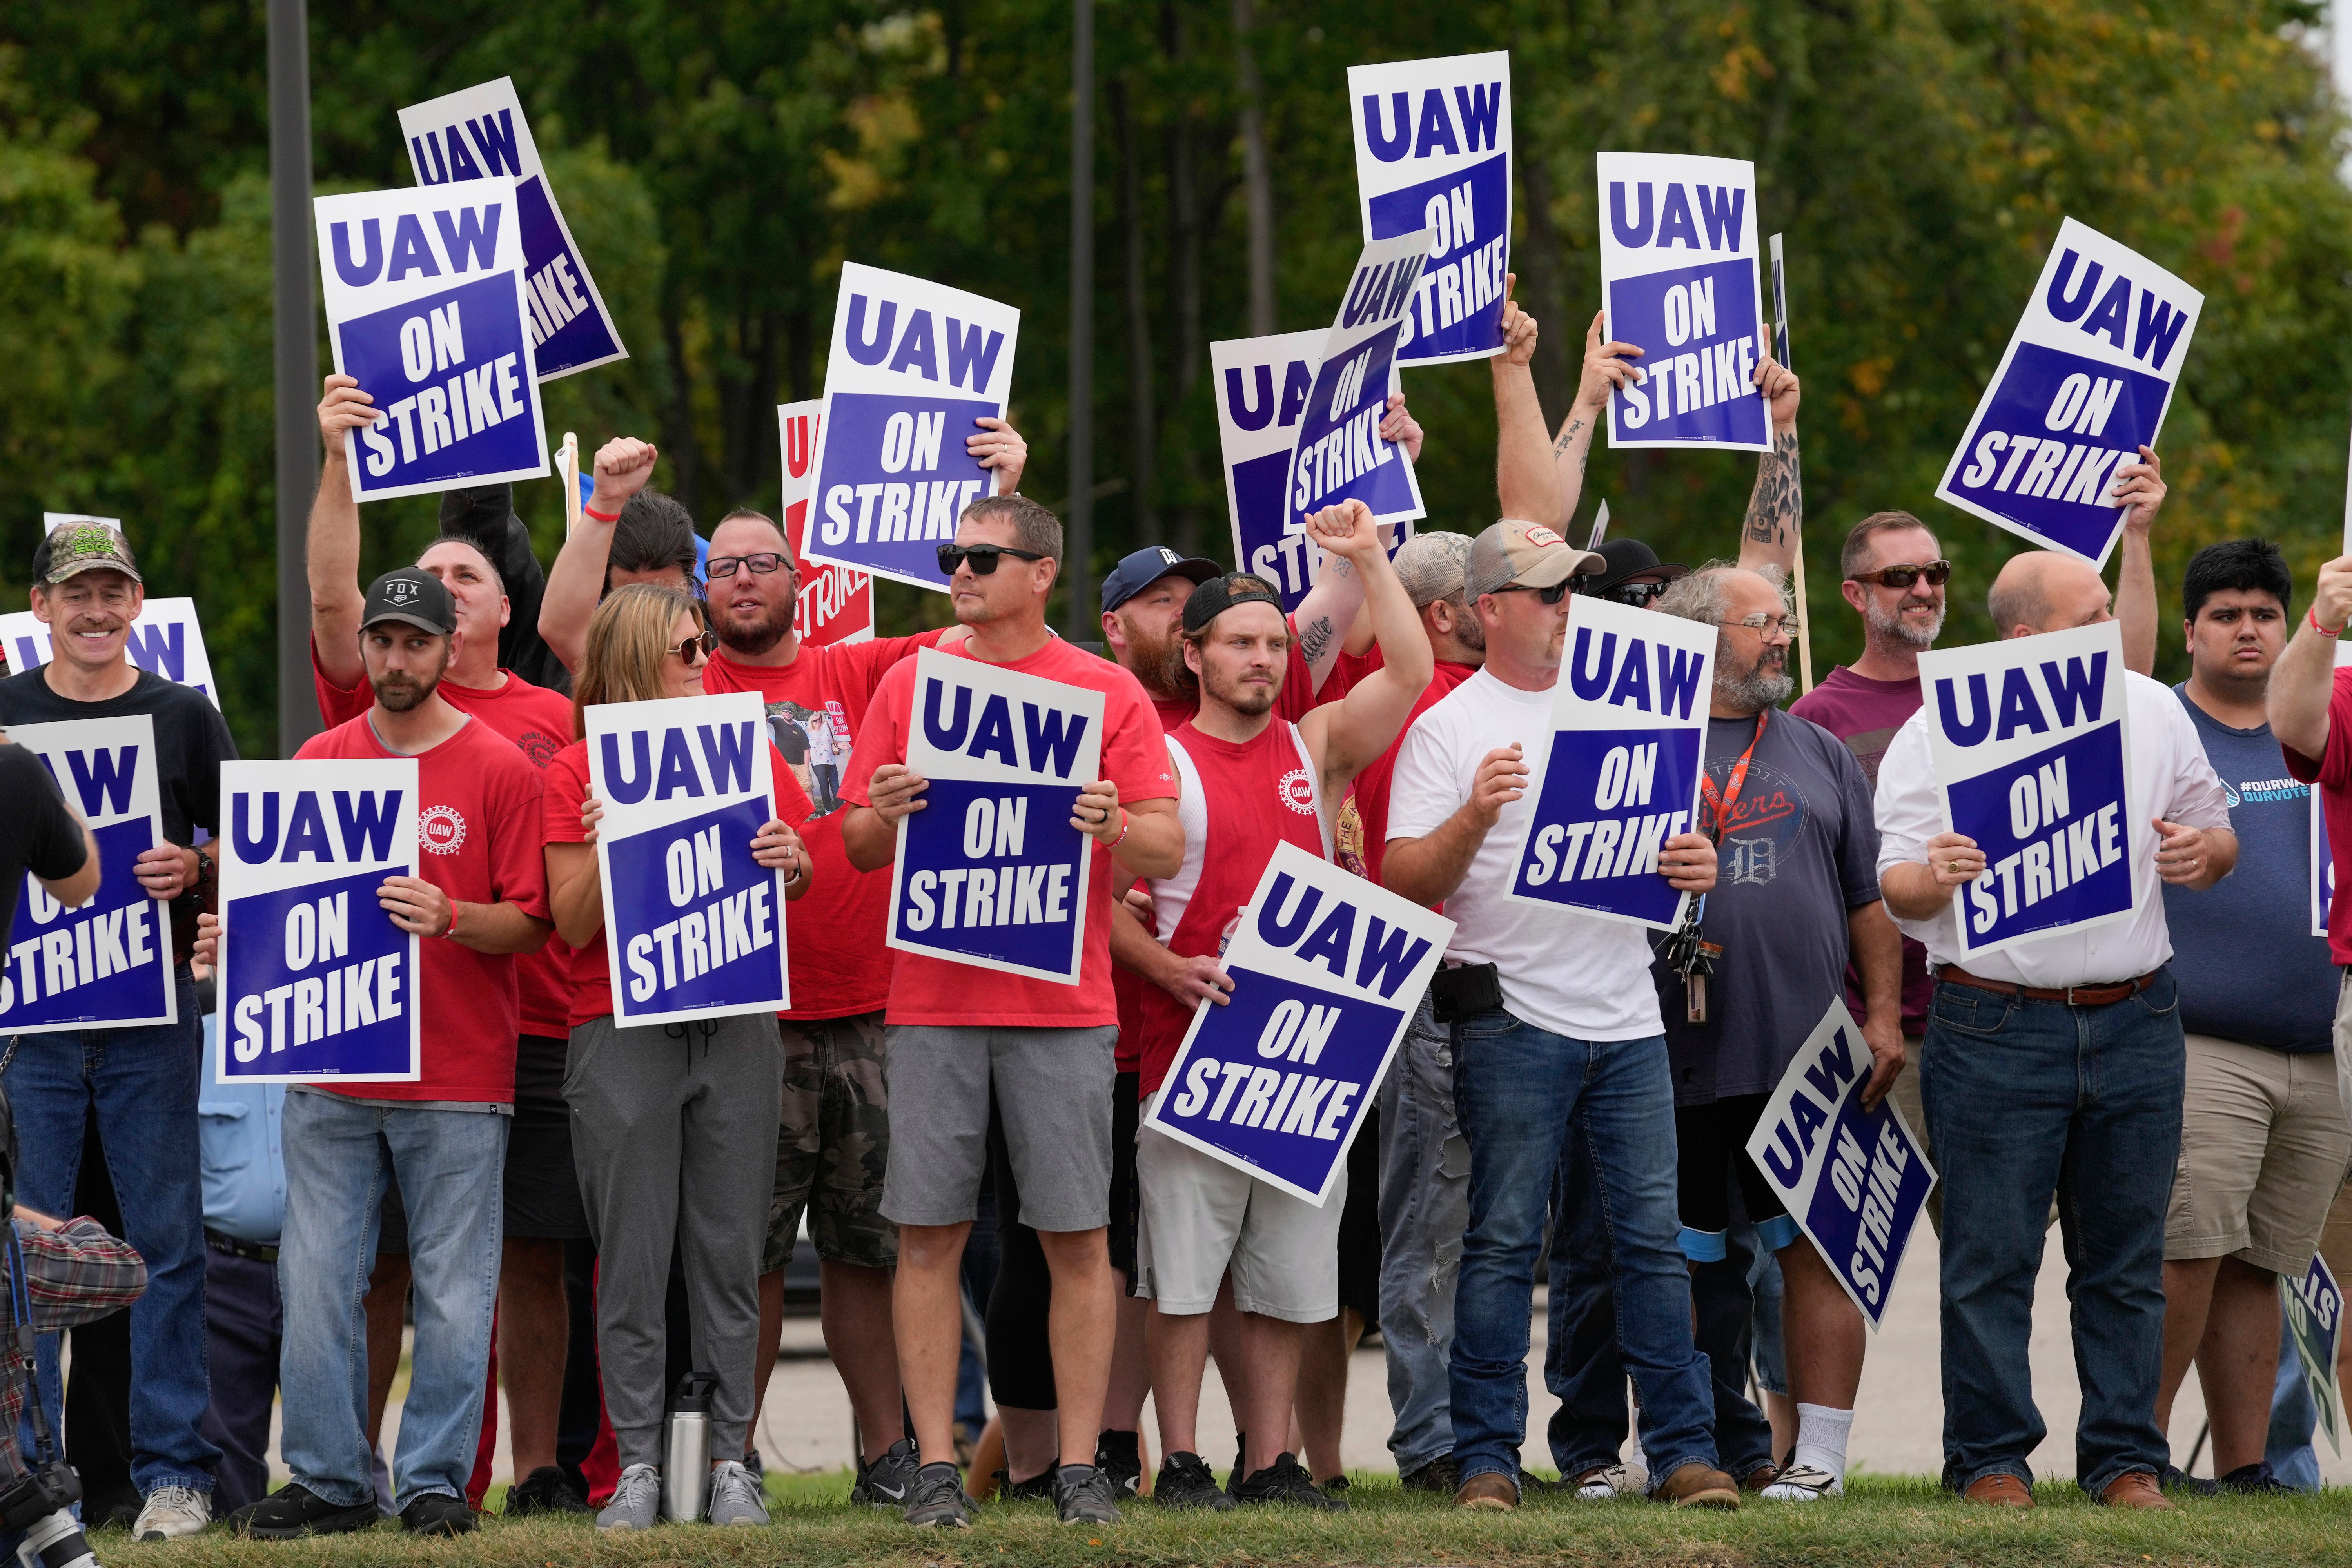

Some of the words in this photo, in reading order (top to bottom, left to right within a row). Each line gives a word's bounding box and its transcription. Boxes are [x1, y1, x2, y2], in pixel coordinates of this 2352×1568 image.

[412, 108, 522, 186] UAW
[1363, 82, 1501, 162] UAW
[331, 204, 501, 287] UAW
[1425, 180, 1475, 258] ON
[1610, 182, 1745, 252] UAW
[1342, 254, 1425, 330] UAW
[1664, 276, 1716, 346] ON
[2047, 248, 2188, 371] UAW
[400, 301, 465, 382] ON
[846, 294, 1004, 394] UAW
[363, 352, 524, 477] STRIKE
[1225, 360, 1312, 431] UA
[1330, 347, 1372, 422] ON
[1623, 335, 1757, 429] STRIKE
[2045, 373, 2123, 436] ON
[787, 415, 822, 478] U
[881, 412, 946, 473] ON
[1296, 400, 1394, 511] STRIKE
[1962, 430, 2142, 508] STRIKE
[70, 537, 114, 546] REALTREE
[74, 544, 114, 555] EDGE
[386, 583, 419, 595] FOX
[1571, 627, 1704, 720] UAW
[1935, 651, 2107, 747] UAW
[836, 715, 844, 725] ON
[924, 677, 1088, 779] UAW
[601, 721, 754, 804] UAW
[1291, 786, 1310, 797] UAW
[1595, 742, 1658, 810] ON
[2010, 756, 2069, 839] ON
[2240, 778, 2310, 791] #OURWA
[2243, 786, 2310, 802] OURVOTE
[233, 790, 403, 864] UAW
[429, 823, 453, 837] UAW
[666, 824, 723, 907] ON
[964, 797, 1027, 858] ON
[1340, 820, 1353, 847] THE
[907, 864, 1071, 931] STRIKE
[1971, 801, 2121, 934] STRIKE
[285, 891, 348, 971] ON
[627, 880, 773, 1002] STRIKE
[1258, 871, 1432, 1000] UAW
[234, 952, 401, 1062] STRIKE
[1258, 1000, 1342, 1065] ON
[1174, 1058, 1360, 1140] STRIKE
[1763, 1025, 1855, 1189] UAW
[1831, 1123, 1867, 1212] ON
[1851, 1119, 1908, 1305] STRIKE
